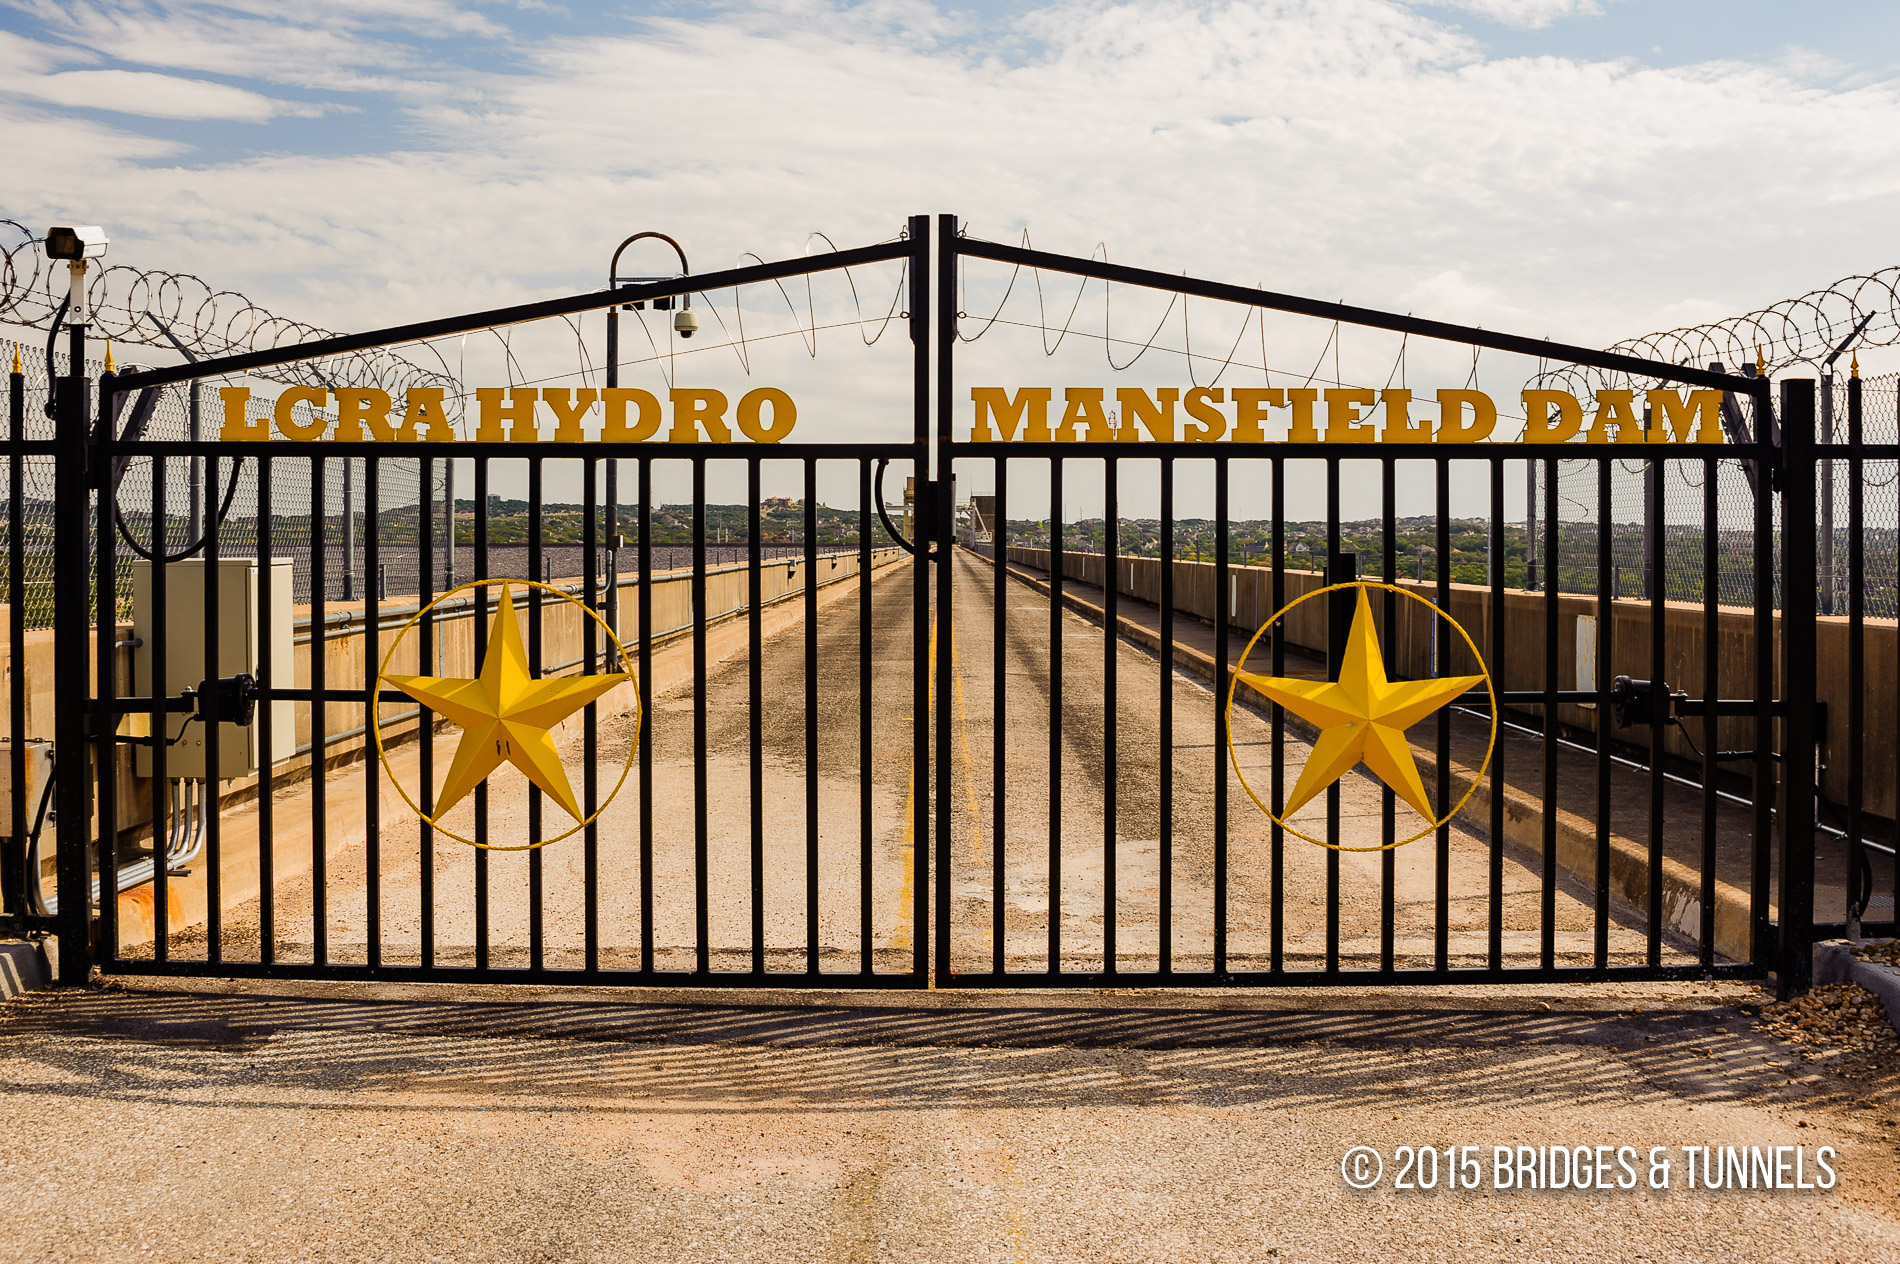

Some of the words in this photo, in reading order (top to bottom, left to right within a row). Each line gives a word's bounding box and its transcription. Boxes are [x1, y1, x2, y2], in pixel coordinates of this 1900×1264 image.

[220, 385, 456, 442] LCRA
[475, 387, 798, 443] HYDRO
[970, 387, 1497, 443] MANSFIELD
[1522, 388, 1725, 444] DAM
